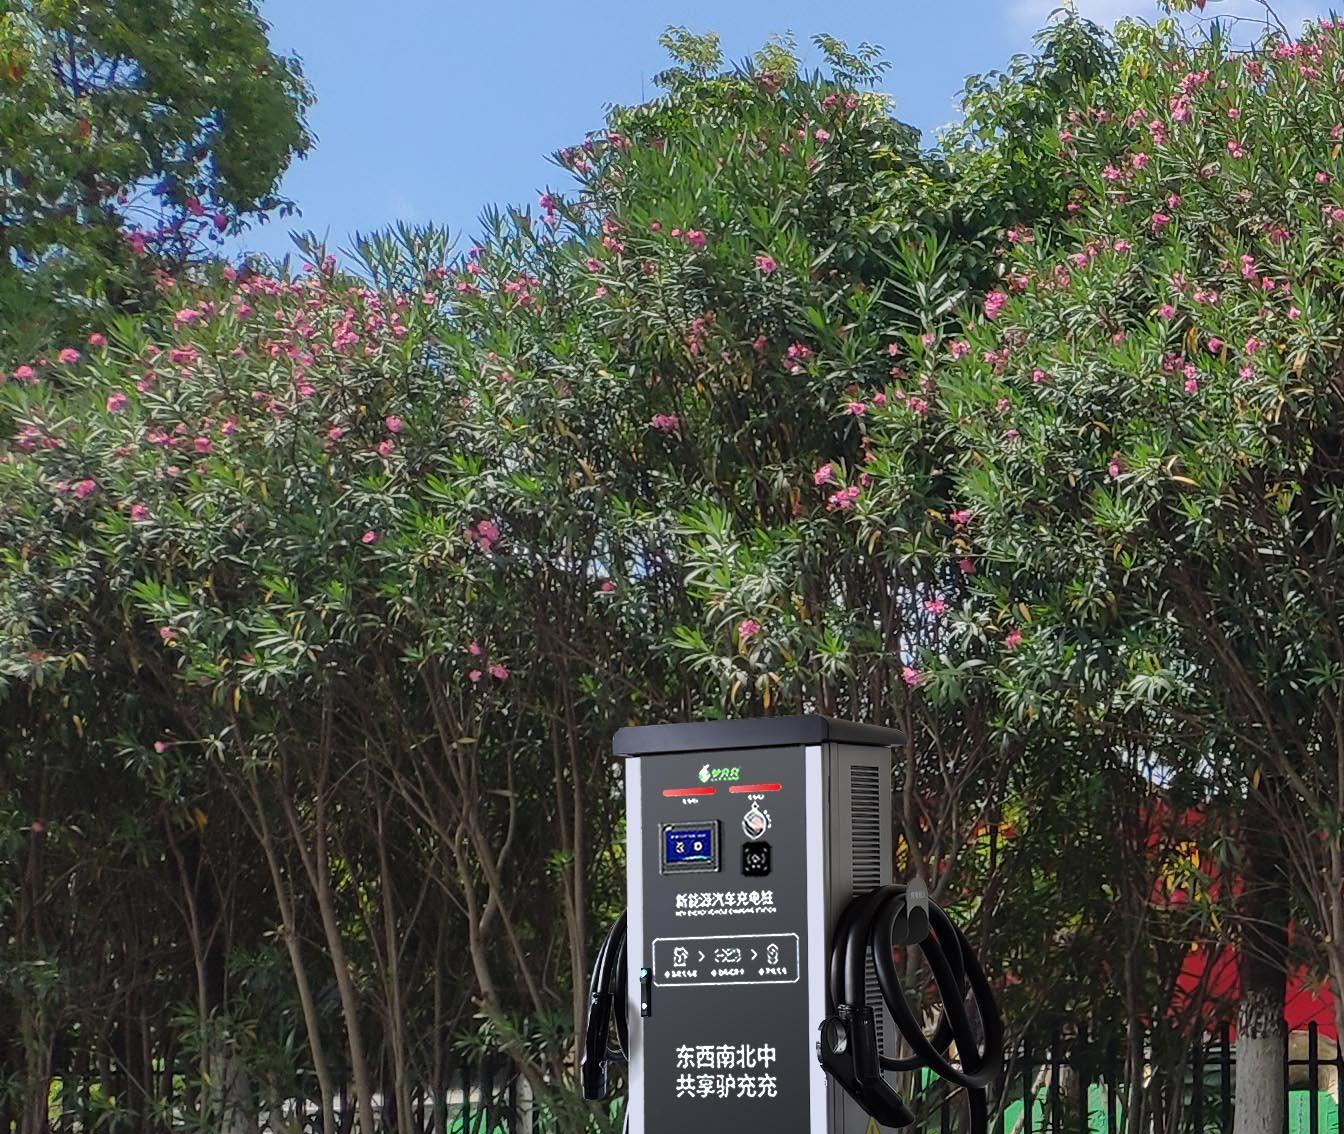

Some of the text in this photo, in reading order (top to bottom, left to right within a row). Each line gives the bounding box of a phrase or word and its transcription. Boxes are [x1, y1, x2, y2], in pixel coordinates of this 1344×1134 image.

[675, 890, 773, 909] 新能源汽车充电桩
[675, 1044, 777, 1069] 东西南北中
[675, 1073, 778, 1099] 共享驴充充
